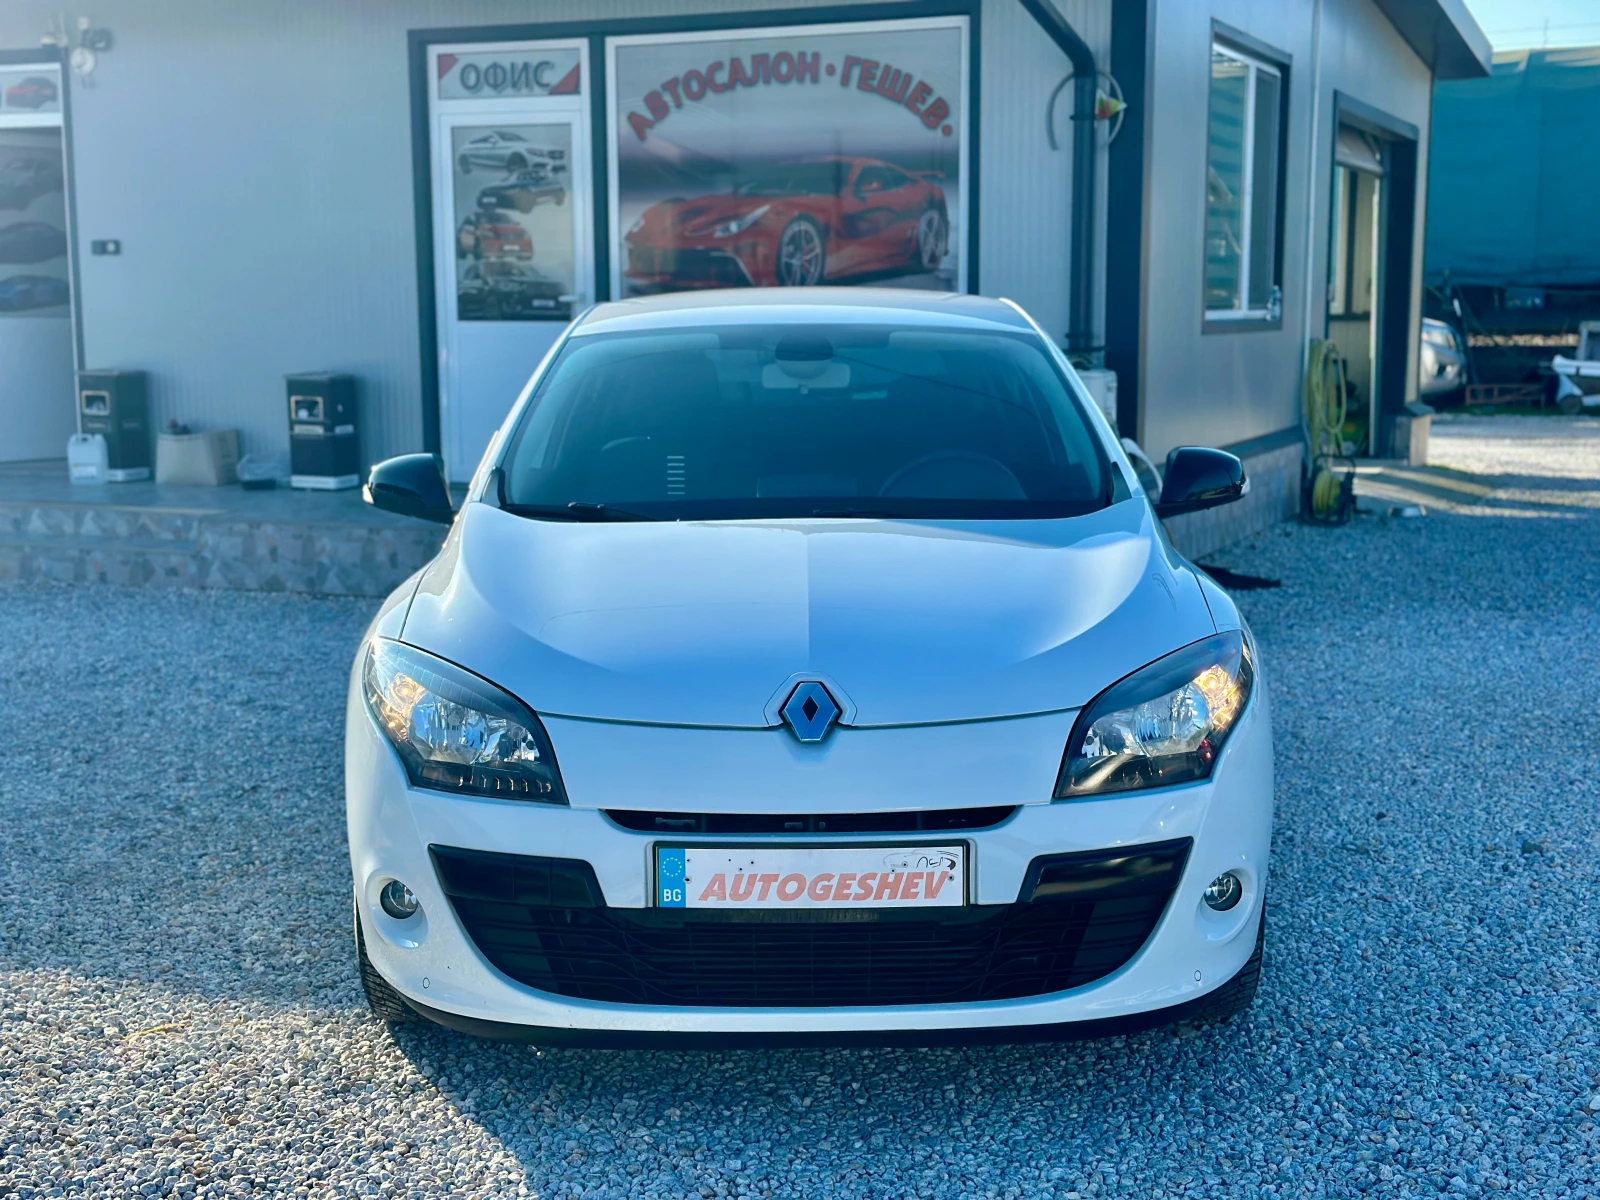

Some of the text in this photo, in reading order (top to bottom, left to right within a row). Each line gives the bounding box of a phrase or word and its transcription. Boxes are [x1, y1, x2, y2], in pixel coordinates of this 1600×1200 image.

[460, 61, 554, 93] ОФИС
[627, 52, 949, 141] АВТОСАЛОН ГЕШЕВ
[663, 888, 682, 902] BG
[698, 872, 950, 902] AUTOGESHEV
